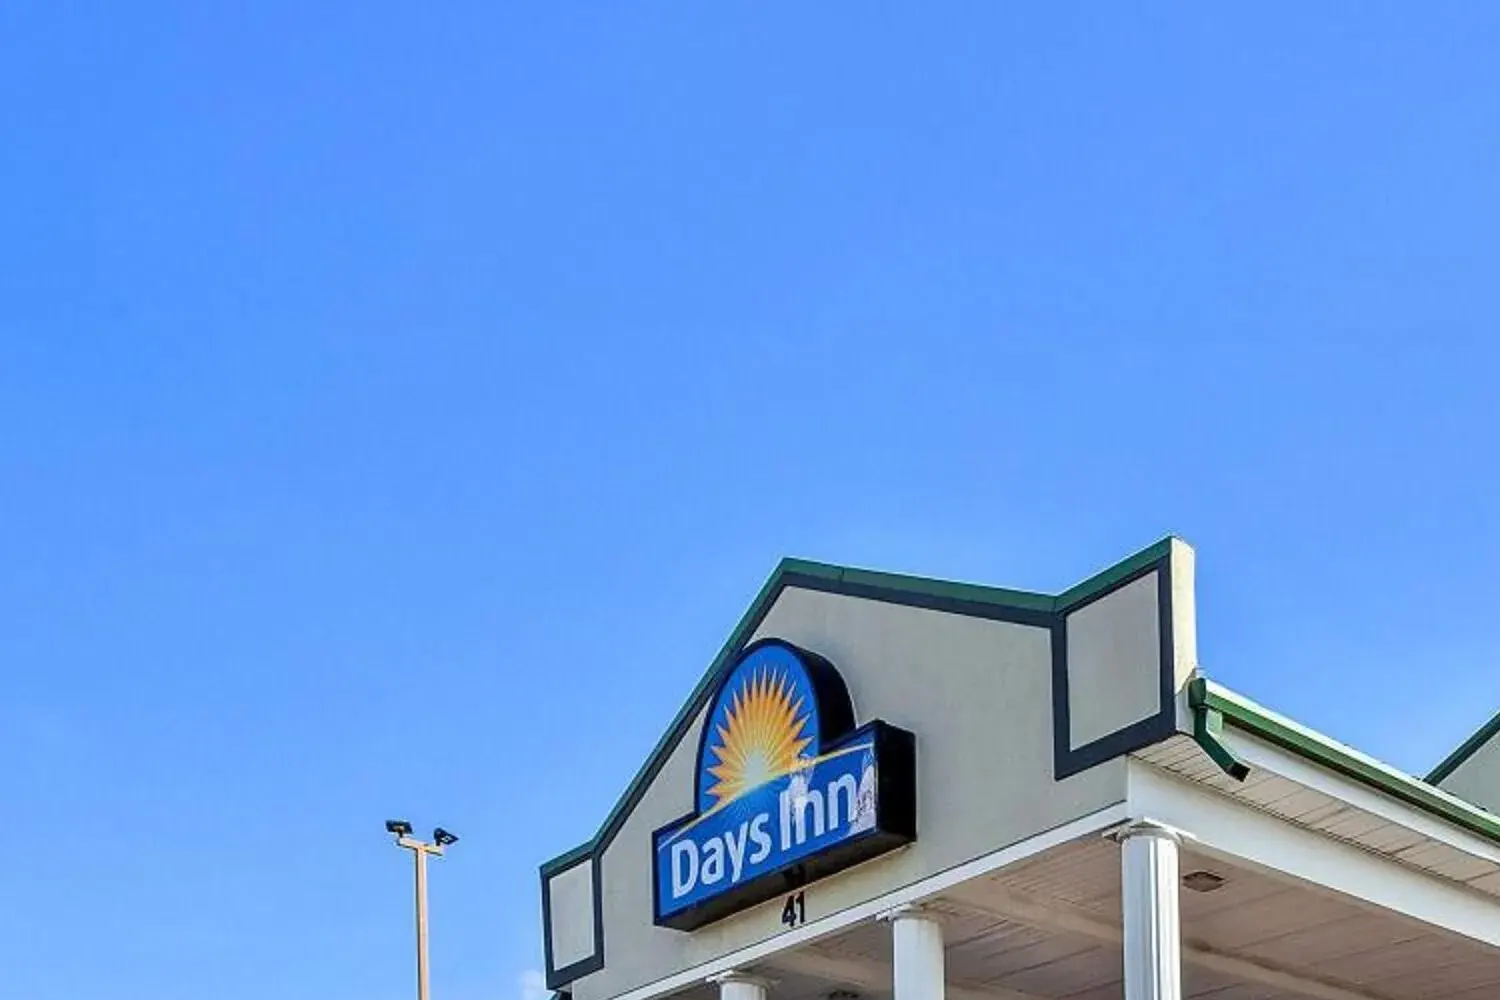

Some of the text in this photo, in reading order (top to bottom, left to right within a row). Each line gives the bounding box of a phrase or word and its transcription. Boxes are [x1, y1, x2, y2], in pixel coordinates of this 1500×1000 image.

[670, 773, 857, 899] Days Inn
[781, 891, 806, 927] 41
